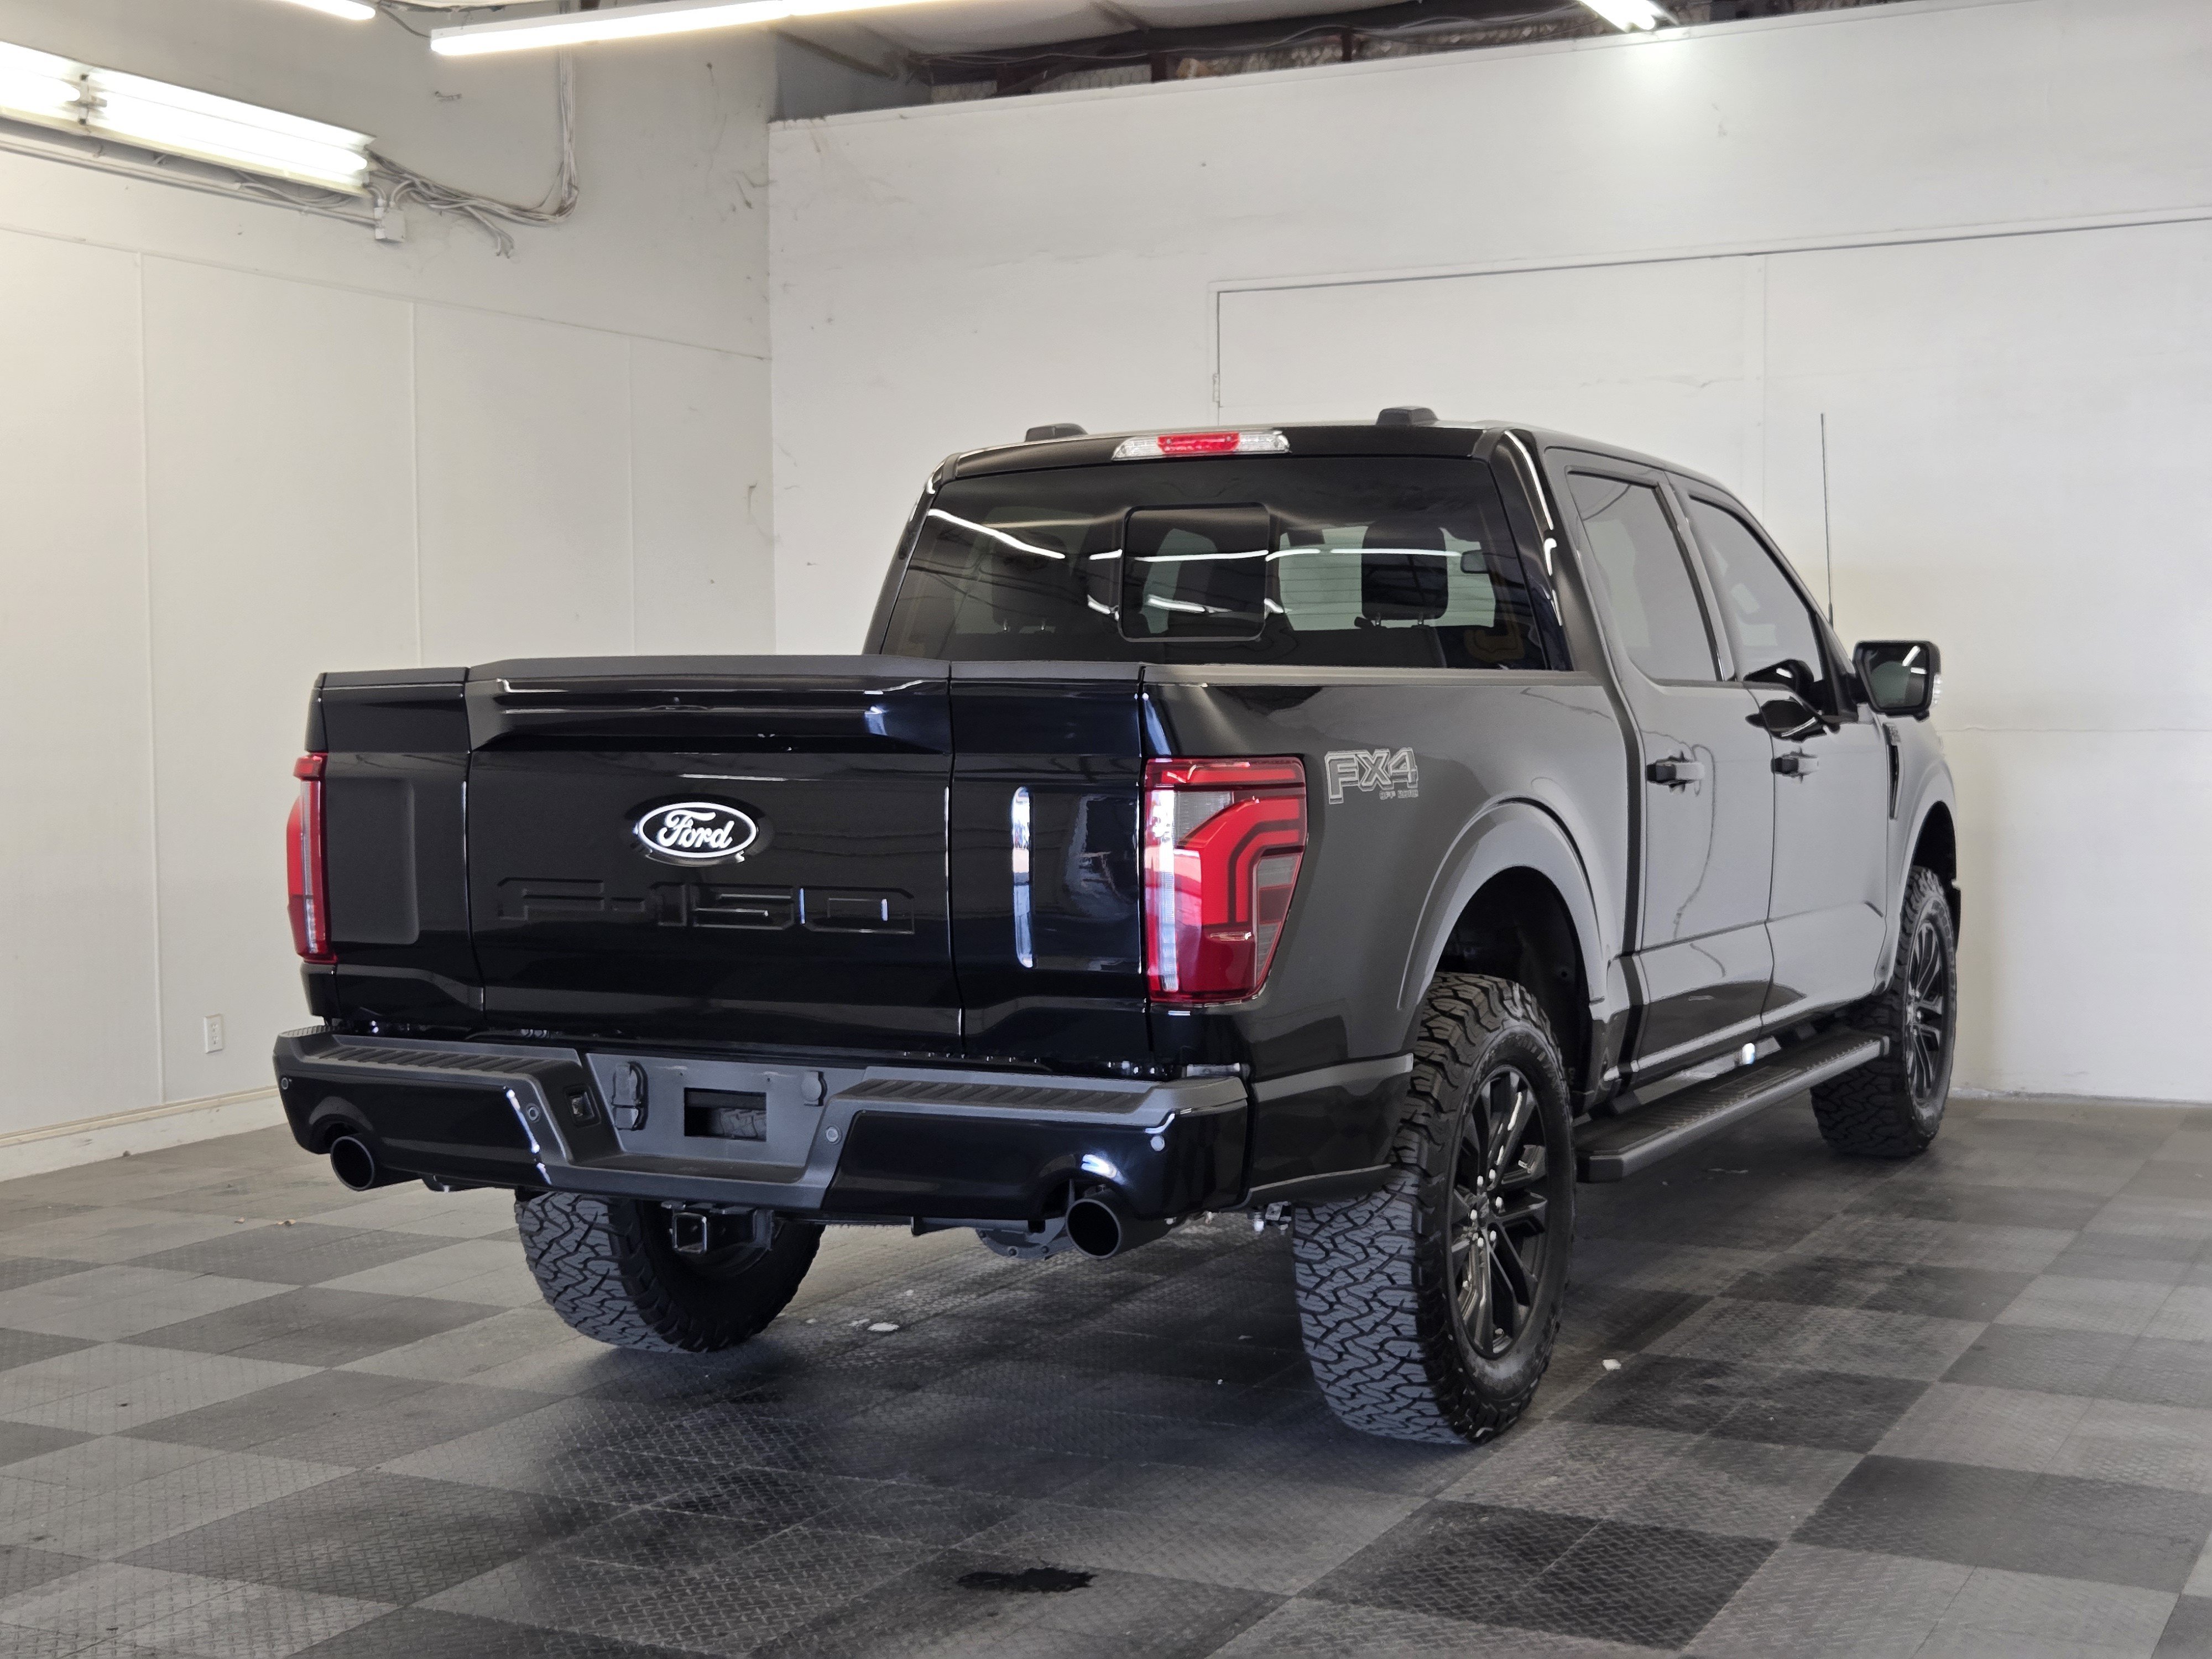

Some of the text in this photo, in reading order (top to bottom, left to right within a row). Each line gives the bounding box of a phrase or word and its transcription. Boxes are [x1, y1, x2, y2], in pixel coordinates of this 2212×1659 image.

[1324, 747, 1418, 805] FX4
[658, 809, 735, 848] Ford
[498, 877, 915, 935] F-150
